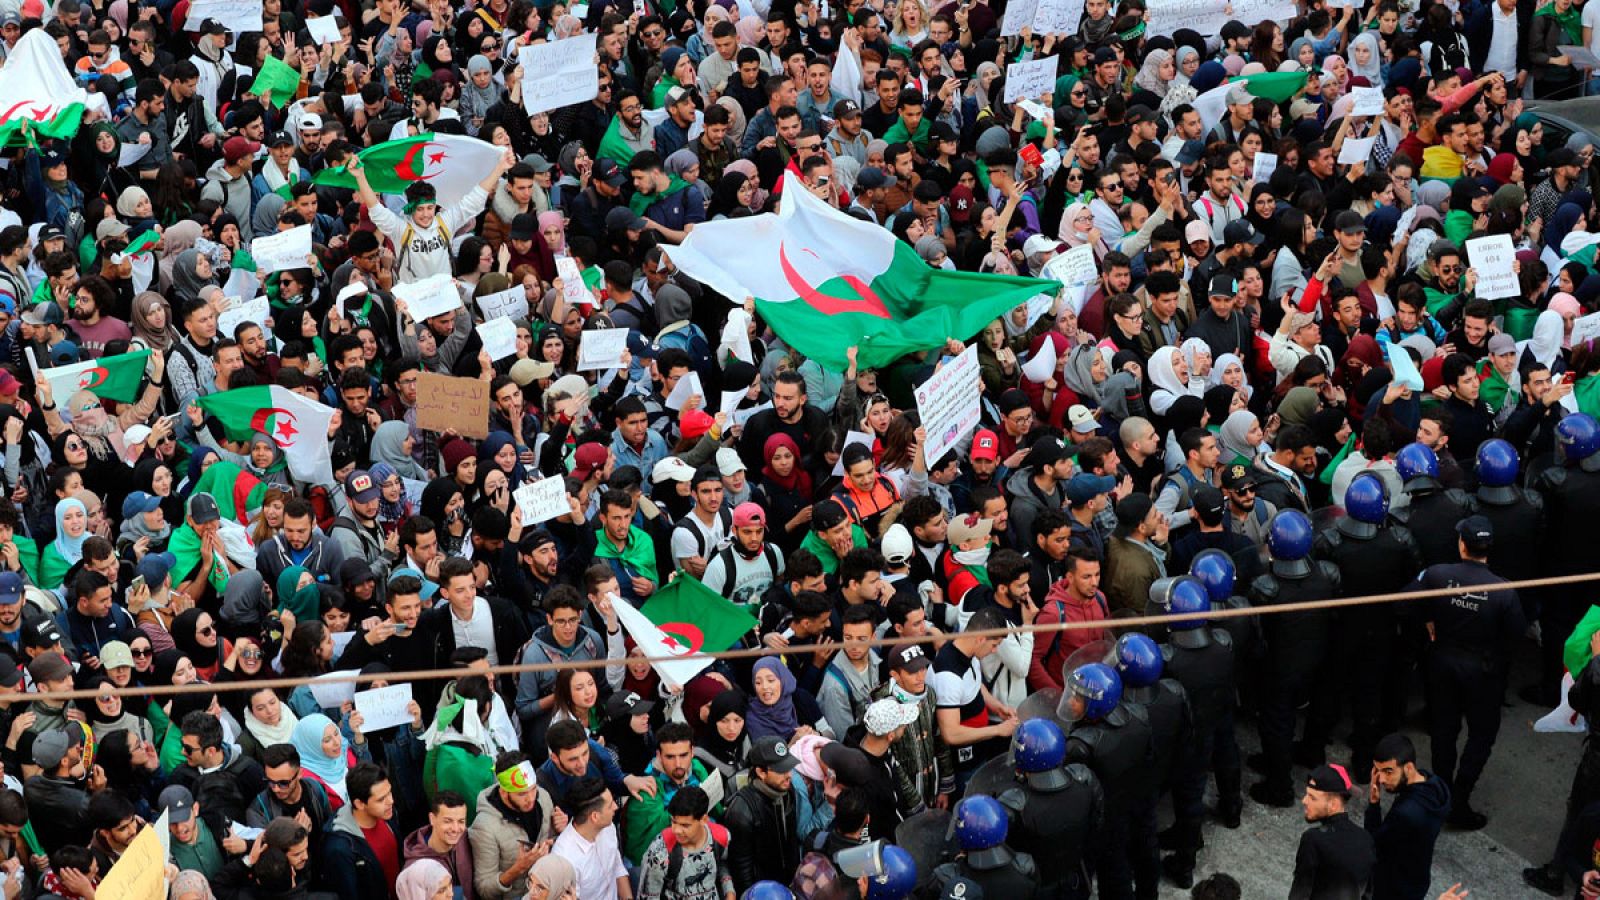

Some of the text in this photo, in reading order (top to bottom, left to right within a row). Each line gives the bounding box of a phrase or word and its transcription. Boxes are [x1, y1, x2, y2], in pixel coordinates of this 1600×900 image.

[1477, 243, 1504, 252] ERROR
[1485, 254, 1501, 264] 404
[1451, 597, 1480, 612] POLICE
